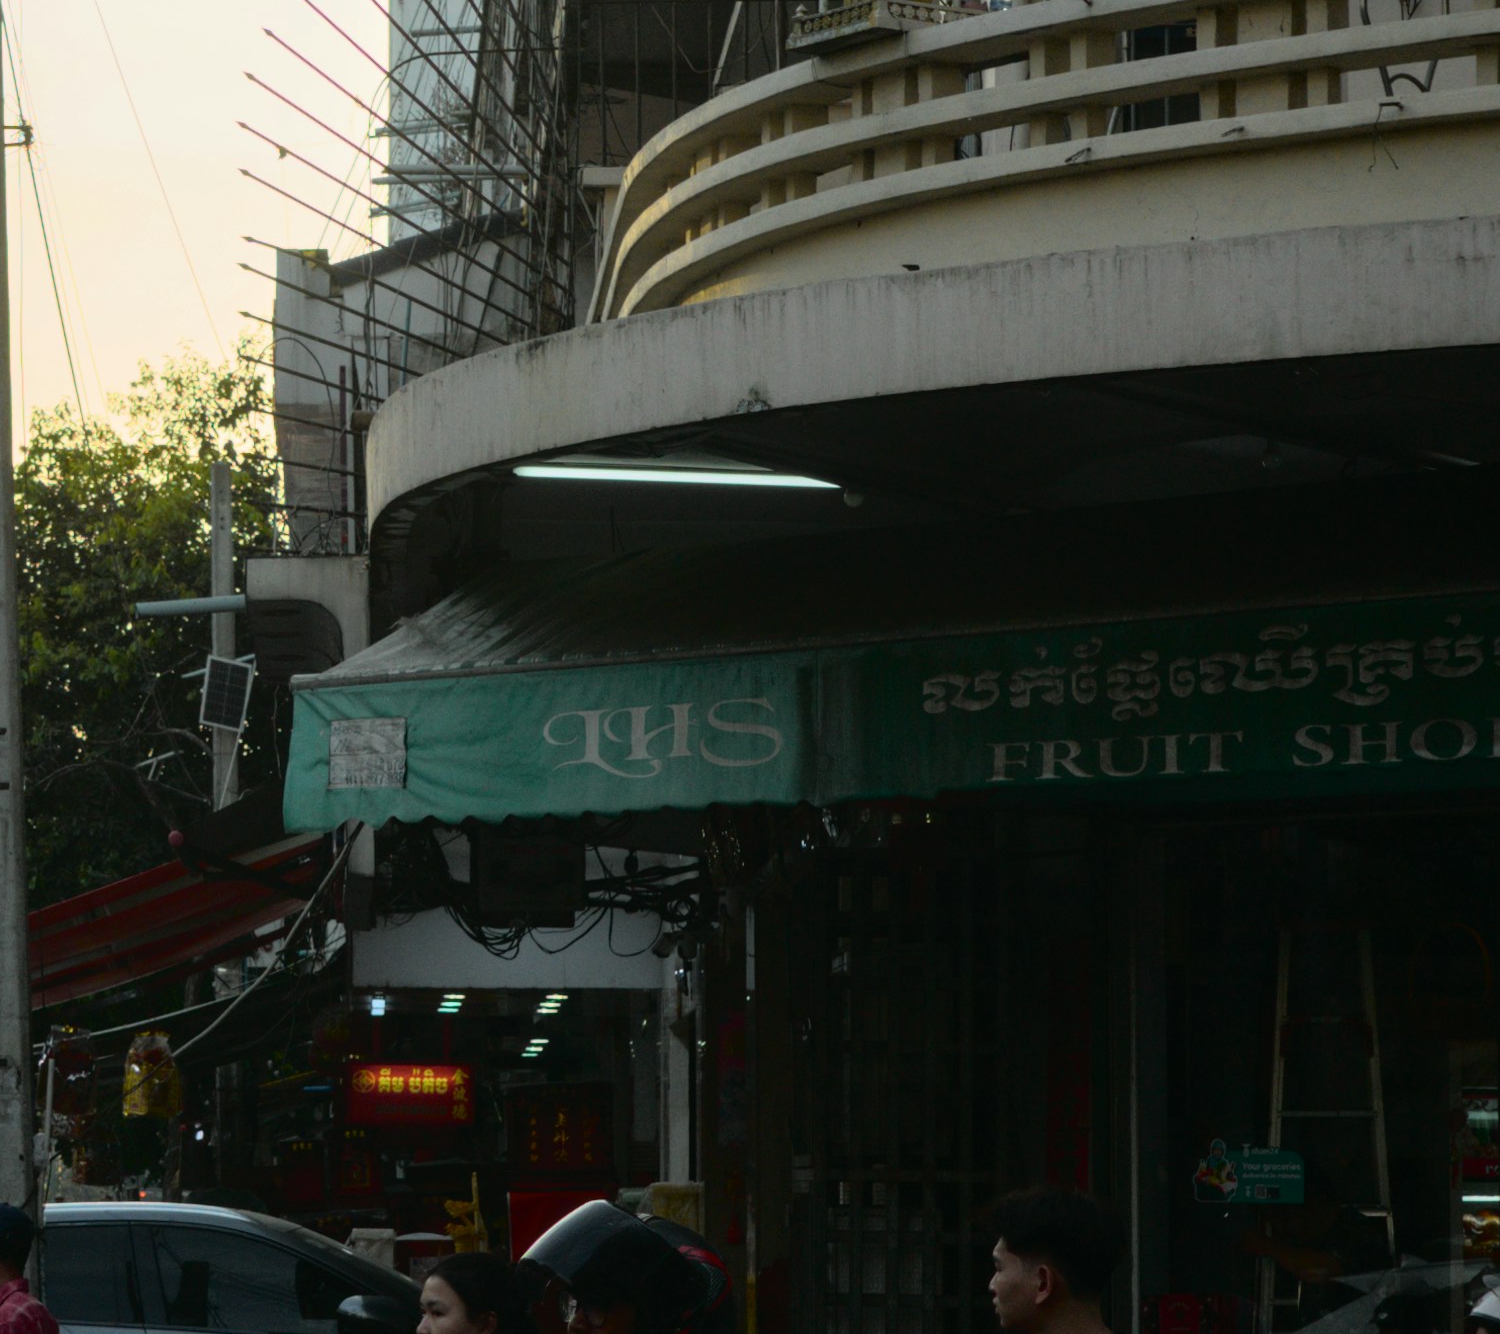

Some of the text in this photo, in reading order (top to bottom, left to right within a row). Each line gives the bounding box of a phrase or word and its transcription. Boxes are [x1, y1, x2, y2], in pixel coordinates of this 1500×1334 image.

[542, 696, 784, 779] LHS
[985, 729, 1244, 784] FRUIT
[1242, 1162, 1302, 1172] Your groceries
